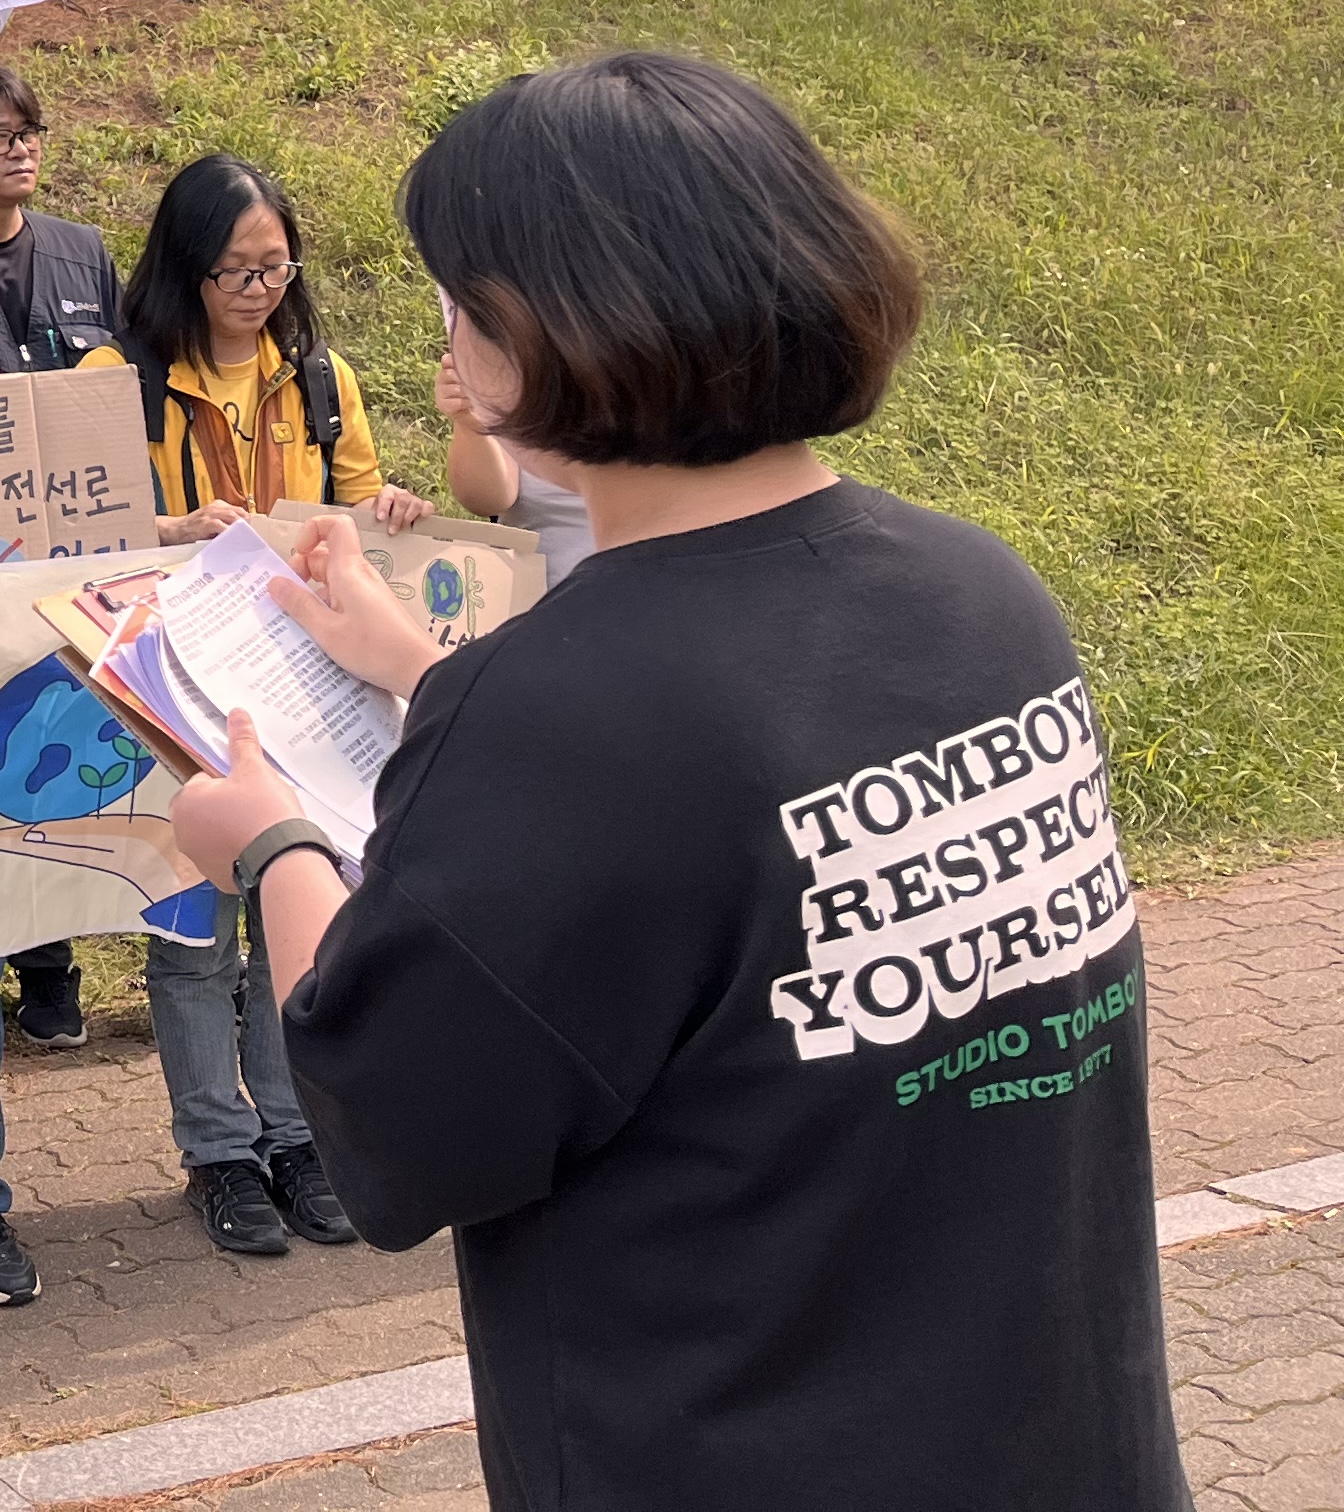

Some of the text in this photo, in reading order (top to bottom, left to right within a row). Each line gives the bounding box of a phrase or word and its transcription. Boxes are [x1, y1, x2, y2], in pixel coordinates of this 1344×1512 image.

[789, 685, 1092, 860] TOMBOY
[810, 761, 1111, 944] RESPECT
[779, 855, 1130, 1033] YOURSEL
[895, 1023, 1030, 1106] STUDIO
[969, 1071, 1075, 1109] SINCE
